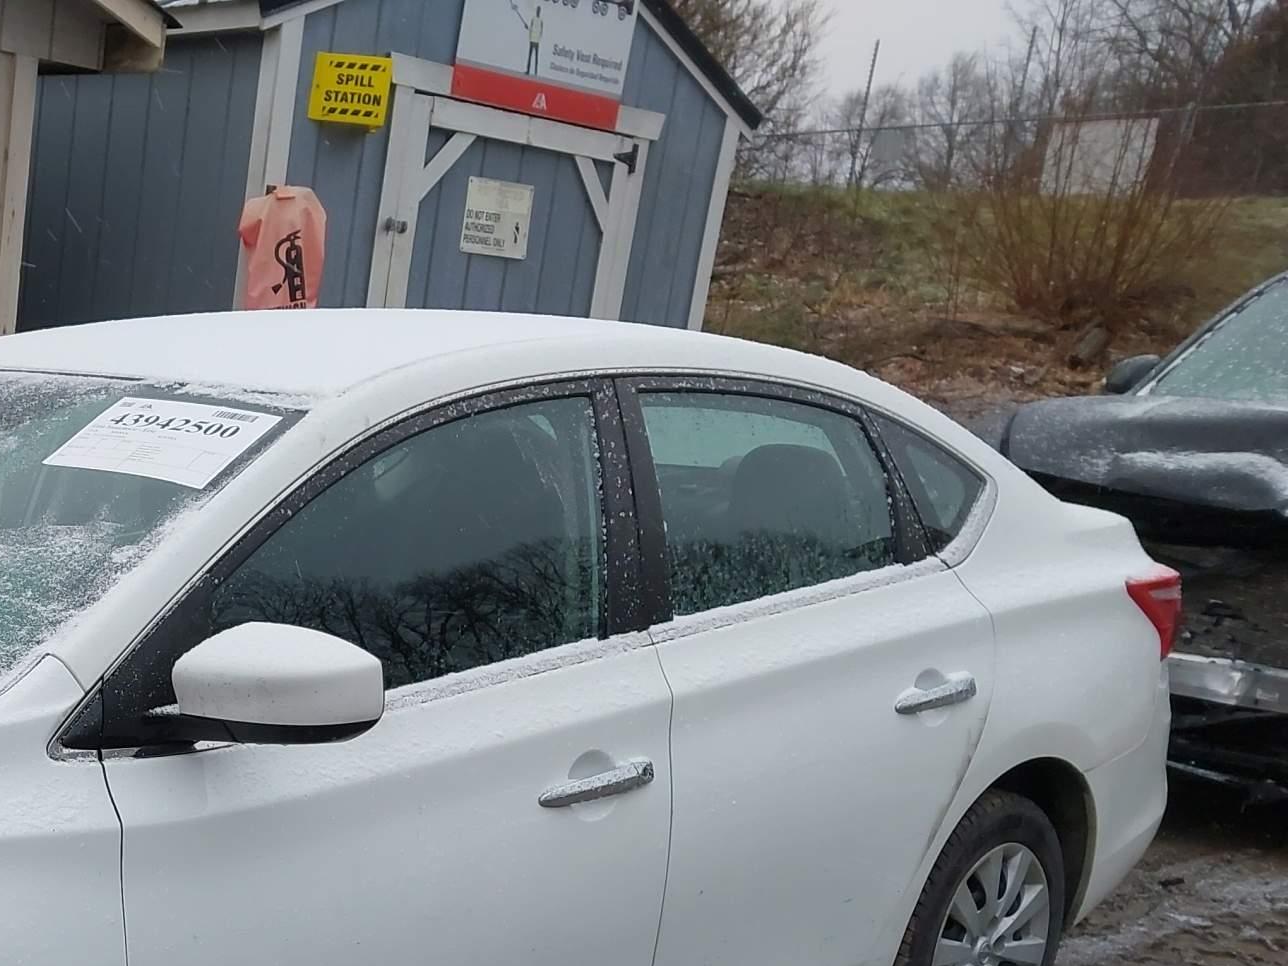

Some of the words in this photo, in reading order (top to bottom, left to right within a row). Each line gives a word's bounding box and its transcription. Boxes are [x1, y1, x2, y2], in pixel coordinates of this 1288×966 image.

[336, 73, 375, 88] SPILL
[323, 90, 382, 106] STATION
[466, 208, 474, 219] DO
[474, 210, 485, 221] NOT
[485, 211, 501, 223] ENTER
[492, 237, 505, 248] ONLY
[110, 412, 241, 439] 43942500
